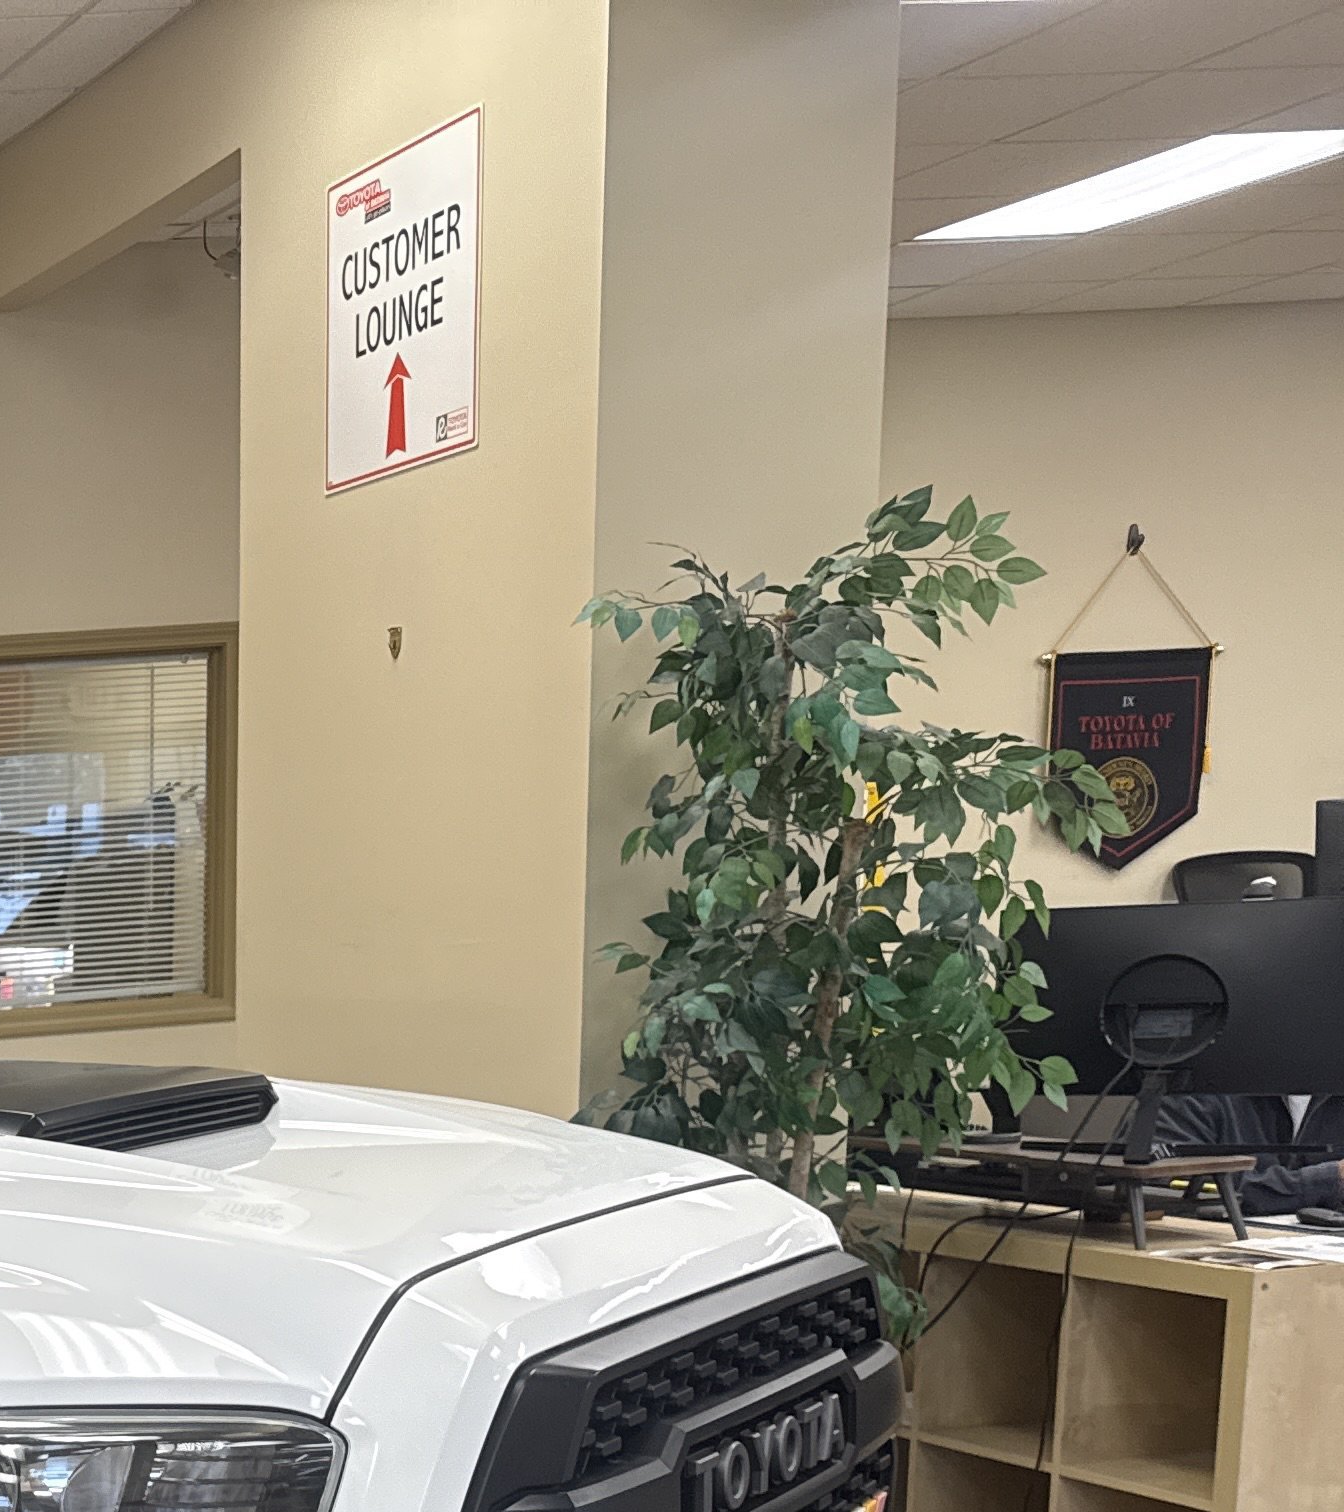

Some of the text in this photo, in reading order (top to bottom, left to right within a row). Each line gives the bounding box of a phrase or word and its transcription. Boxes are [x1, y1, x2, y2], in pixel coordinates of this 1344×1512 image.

[342, 203, 461, 301] CUSTOMER
[356, 276, 444, 358] LOUNGE
[1078, 712, 1176, 733] TOYOTA OF
[1089, 732, 1160, 750] BATAVIA
